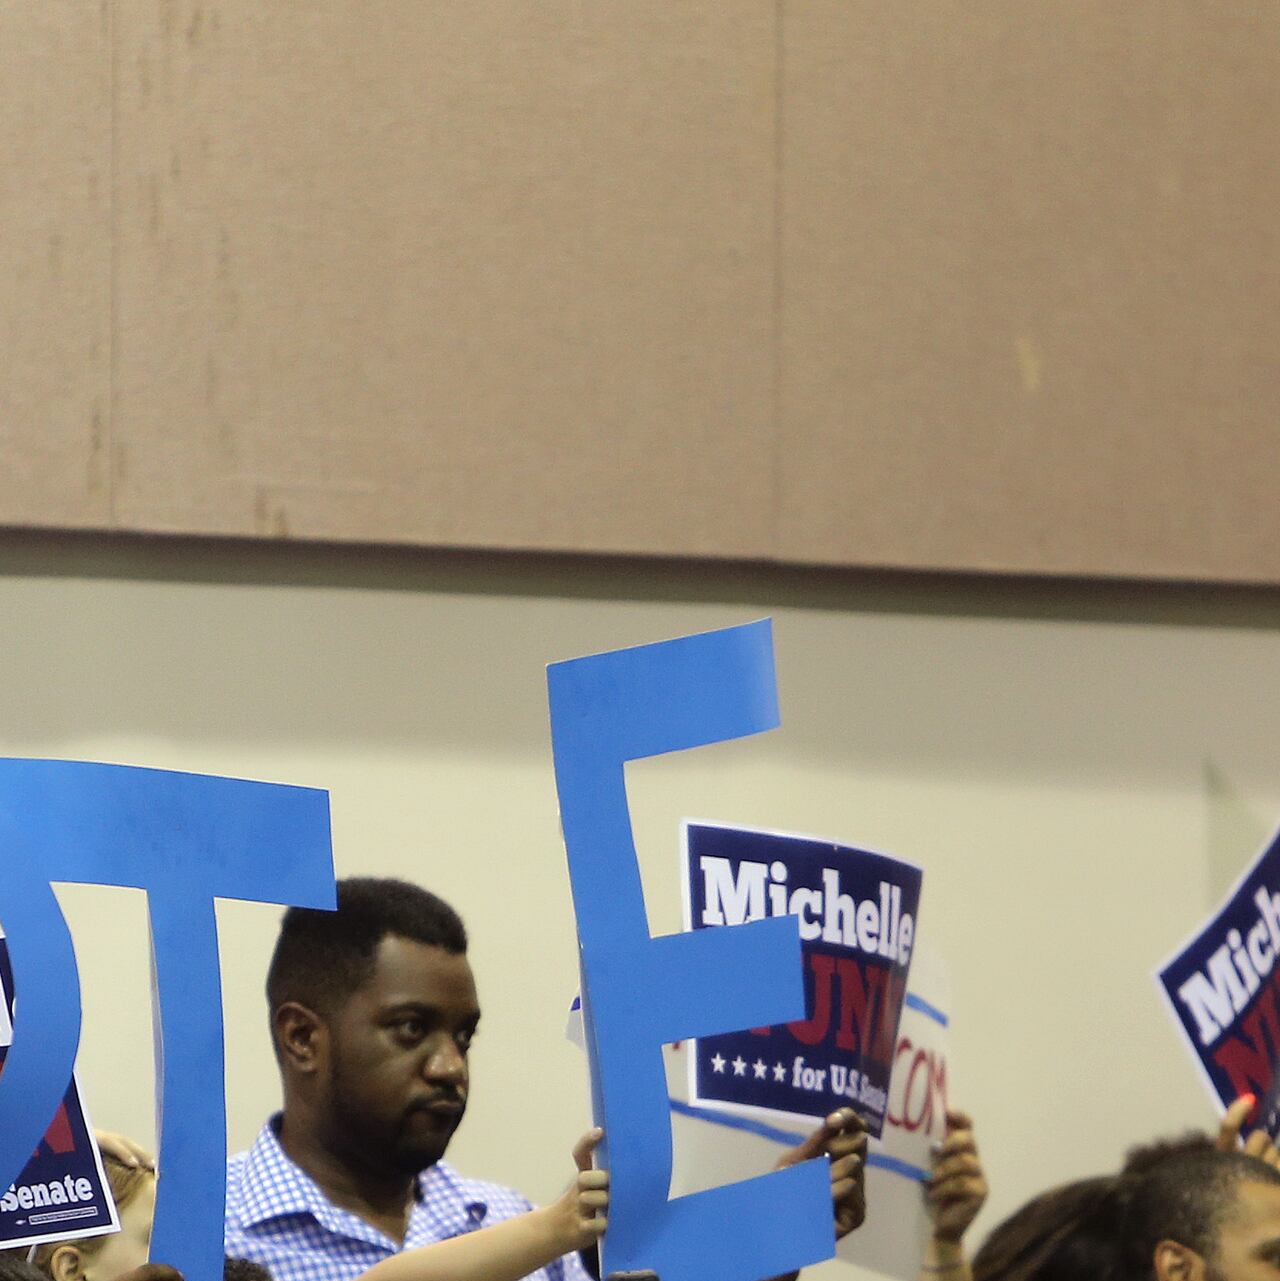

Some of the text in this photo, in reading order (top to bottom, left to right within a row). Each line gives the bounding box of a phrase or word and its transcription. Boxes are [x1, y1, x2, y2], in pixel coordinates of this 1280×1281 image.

[699, 855, 914, 967] Michelle
[791, 1056, 827, 1092] for
[0, 1174, 94, 1213] Senate
